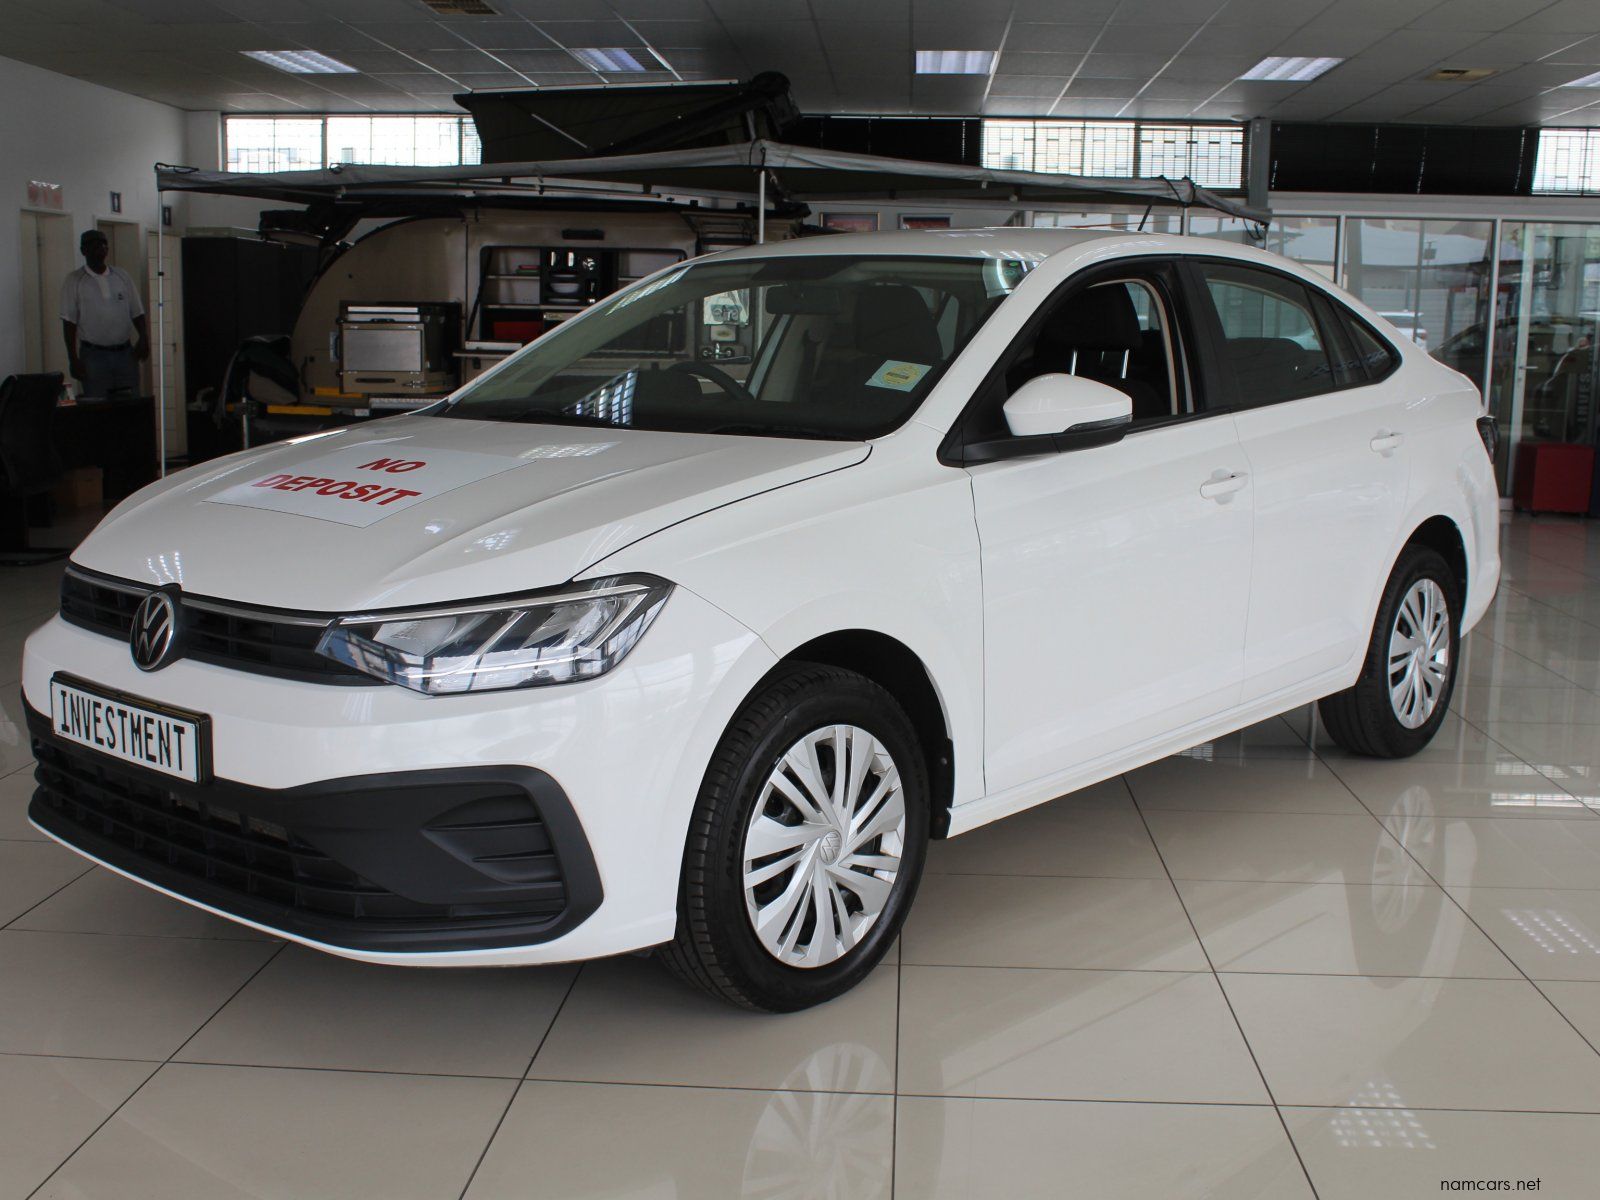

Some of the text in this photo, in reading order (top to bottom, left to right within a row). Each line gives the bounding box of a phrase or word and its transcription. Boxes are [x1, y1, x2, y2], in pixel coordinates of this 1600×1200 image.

[357, 457, 427, 474] NO
[250, 474, 423, 506] DEPOSIT
[60, 690, 185, 771] INVESTMENT
